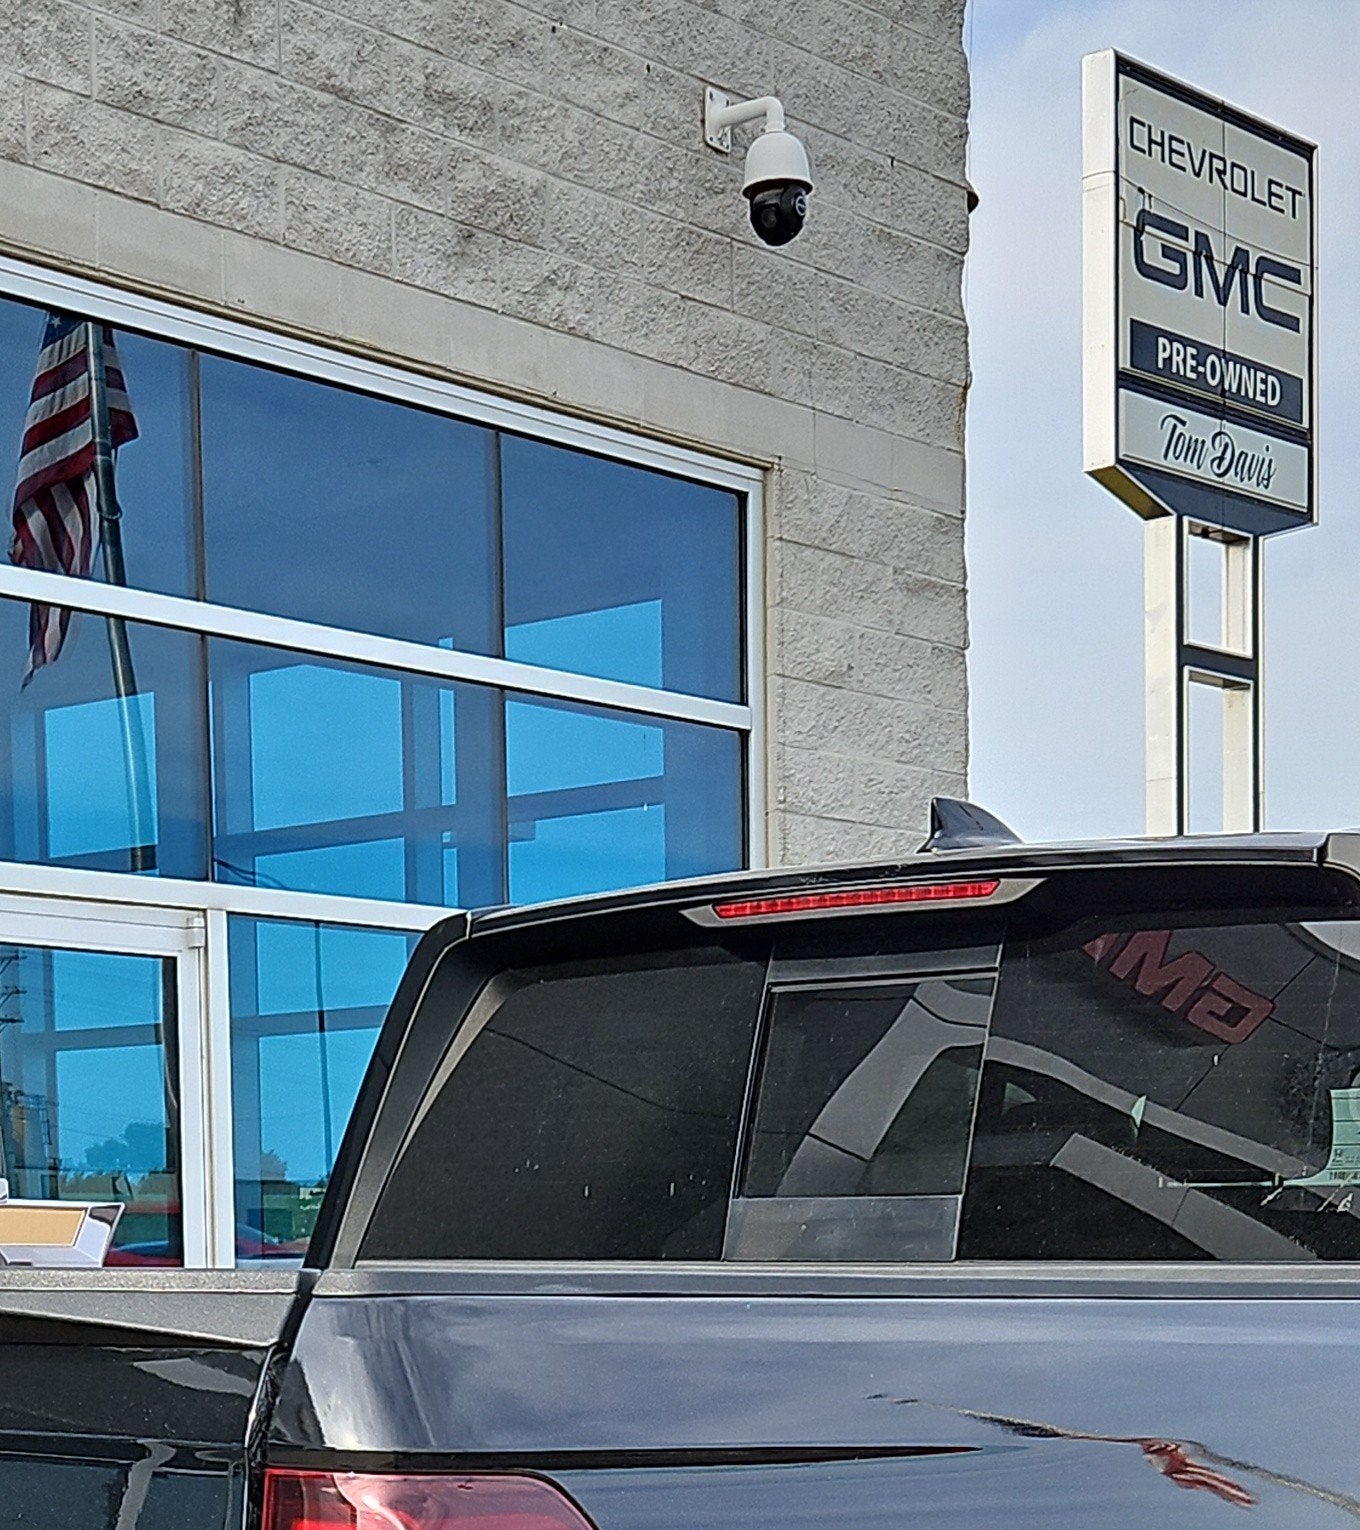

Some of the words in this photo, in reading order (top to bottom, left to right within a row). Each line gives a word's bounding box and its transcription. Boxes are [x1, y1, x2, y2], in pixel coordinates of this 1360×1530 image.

[1128, 116, 1304, 220] CHEVROLET
[1134, 208, 1302, 335] GMC
[1157, 336, 1282, 407] PRE-OWNED
[1160, 413, 1208, 473] Tom
[1209, 429, 1277, 491] Davis
